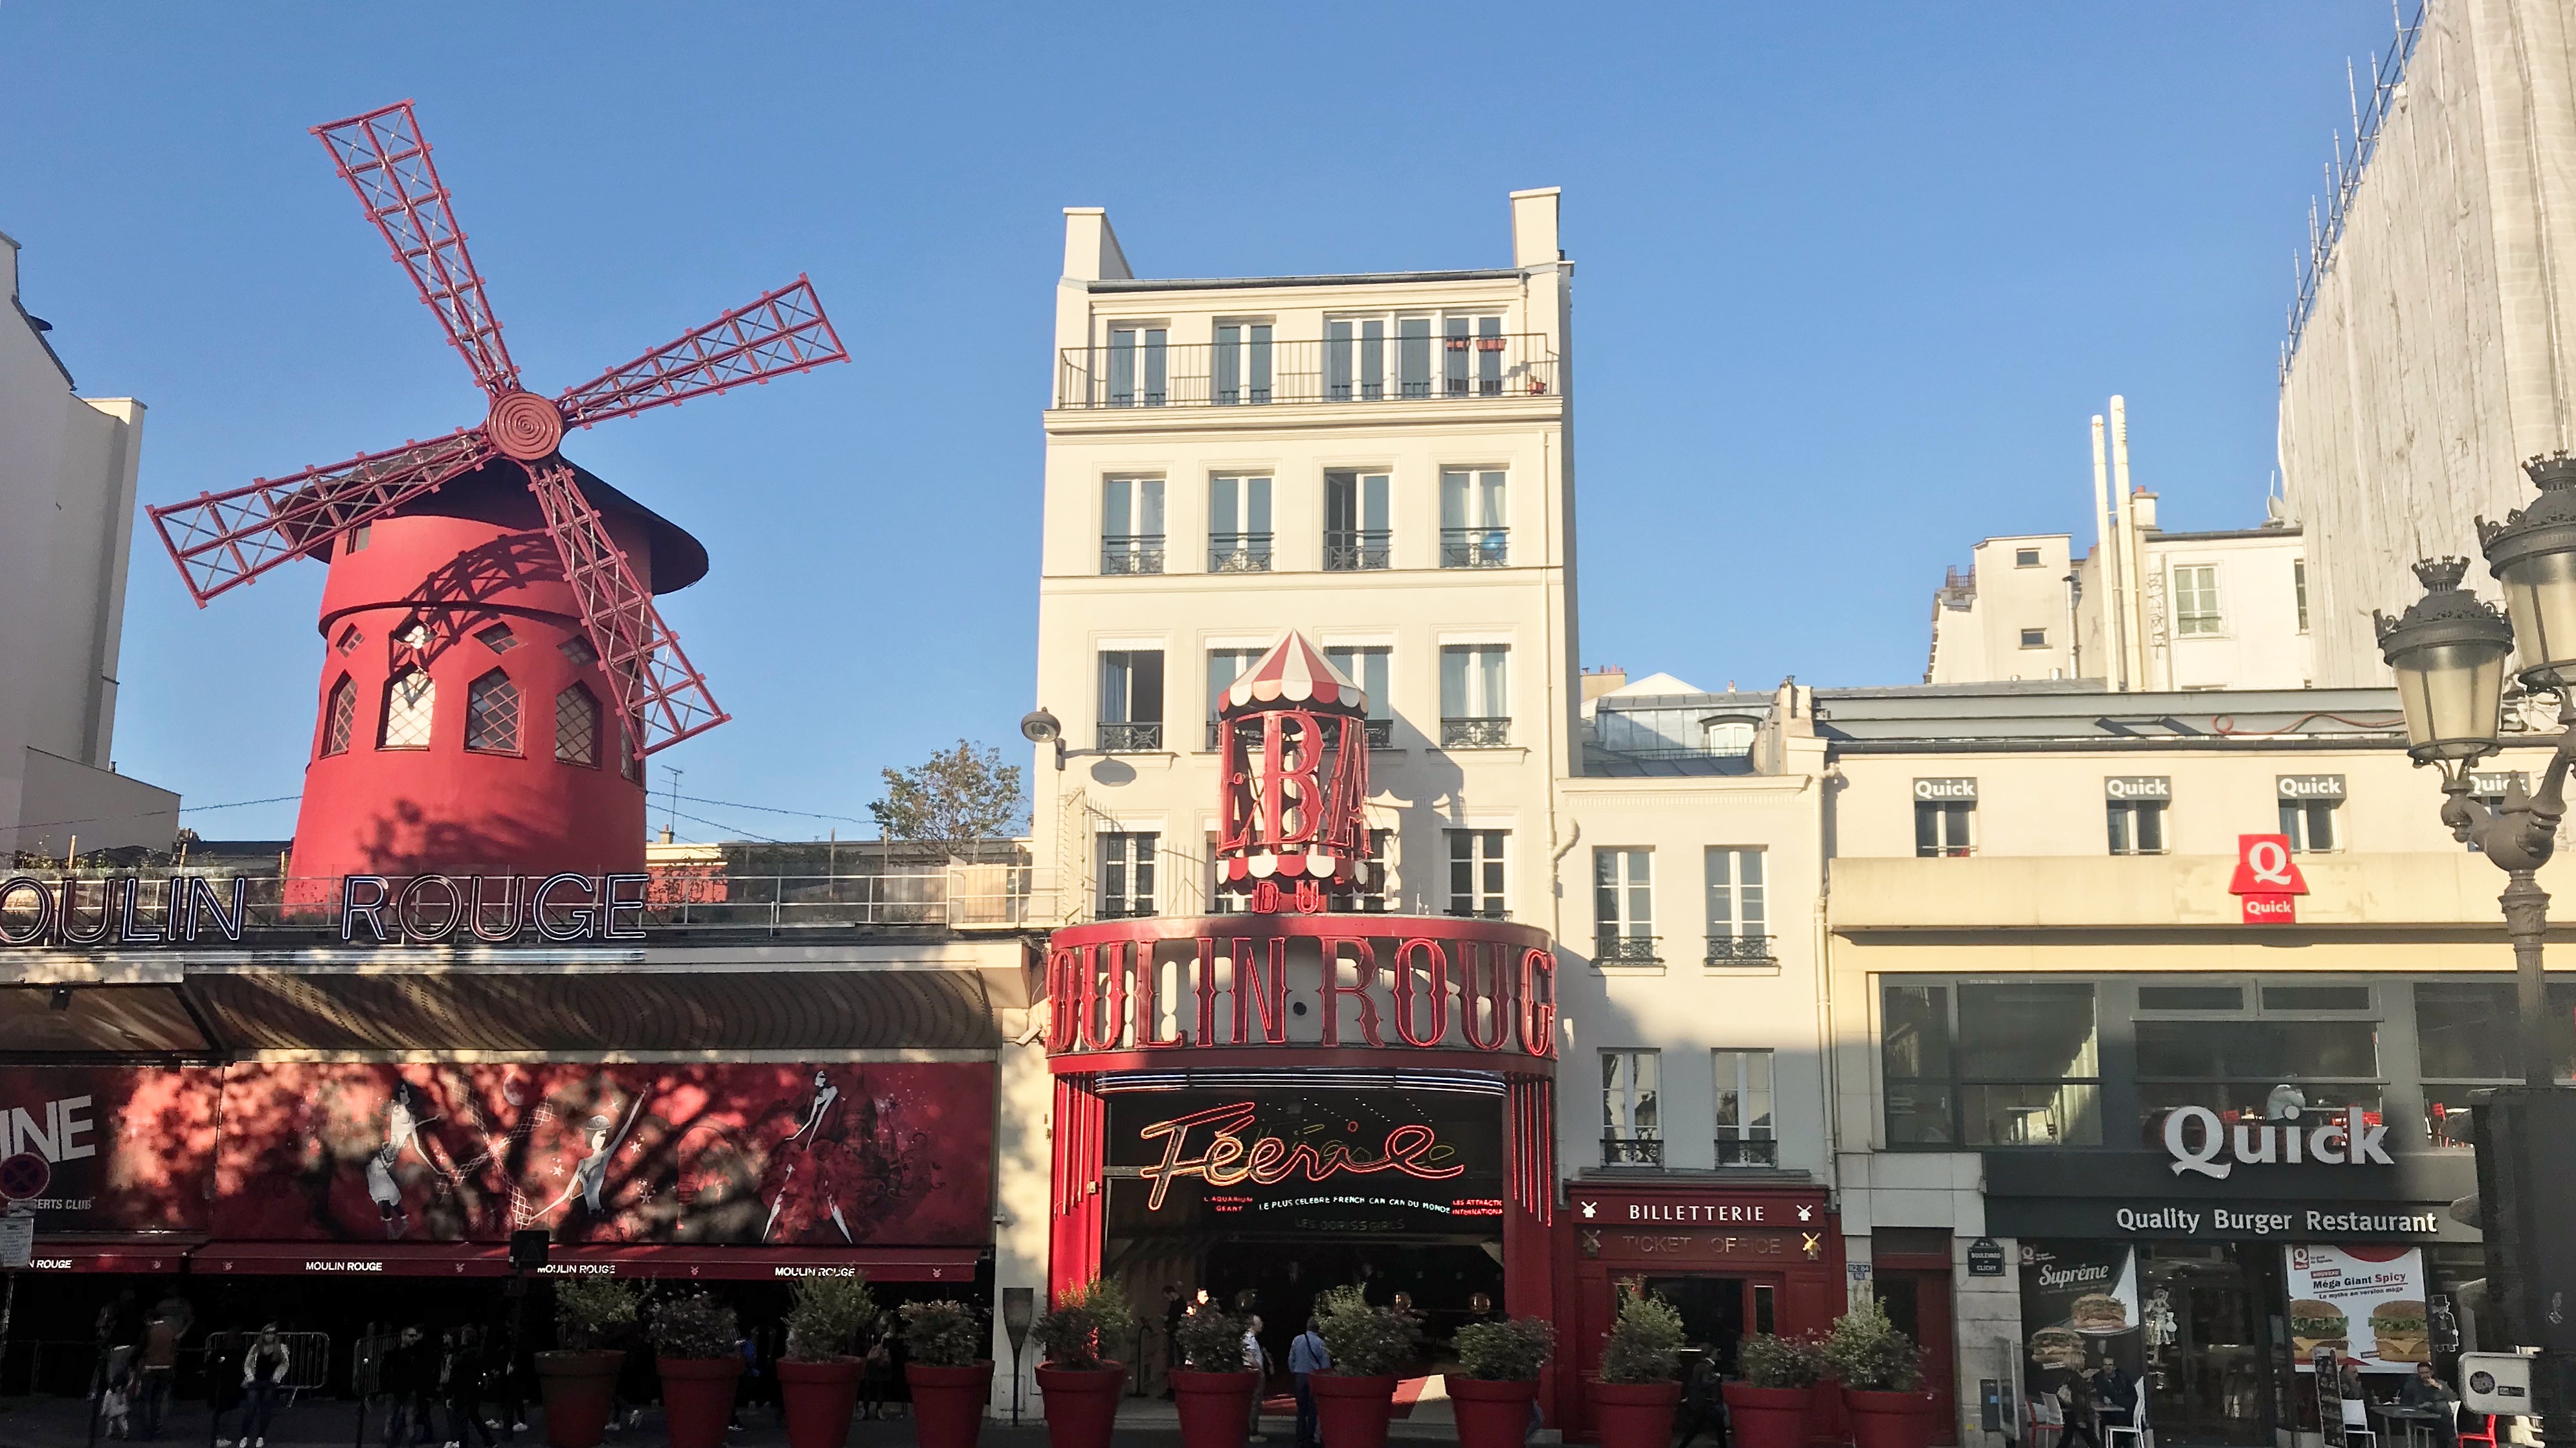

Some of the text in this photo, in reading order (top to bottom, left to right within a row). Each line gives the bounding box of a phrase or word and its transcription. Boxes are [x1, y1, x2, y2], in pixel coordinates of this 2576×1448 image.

[1914, 779, 1975, 799] Quick
[2107, 778, 2169, 799] Quick
[2279, 777, 2342, 797] Quick
[2248, 840, 2292, 886] Q
[1253, 879, 1320, 914] DU
[341, 872, 651, 942] ROUGE
[2246, 900, 2292, 915] Quick
[2164, 1104, 2395, 1180] Quick
[1139, 1101, 1465, 1211] Féerie
[65, 1199, 92, 1210] CLUB
[1259, 1202, 1270, 1211] LE
[1271, 1199, 1294, 1209] PLUS
[1295, 1197, 1330, 1206] CELEBRE
[1332, 1196, 1365, 1205] FRENCH
[1407, 1199, 1420, 1208] DU
[1422, 1202, 1451, 1214] MONDE
[1629, 1204, 1765, 1222] BILLETTERIE
[2116, 1207, 2438, 1234] Quality Burger Restaurant
[1622, 1235, 1782, 1254] TICKET OFFICE
[36, 1260, 73, 1269] ROUGE
[306, 1262, 383, 1271] MOULIN ROUGE
[579, 1264, 616, 1274] ROUGE
[774, 1267, 816, 1276] MOULIN
[2039, 1263, 2109, 1288] Suprême
[2313, 1273, 2406, 1289] Méga Giant Spicy
